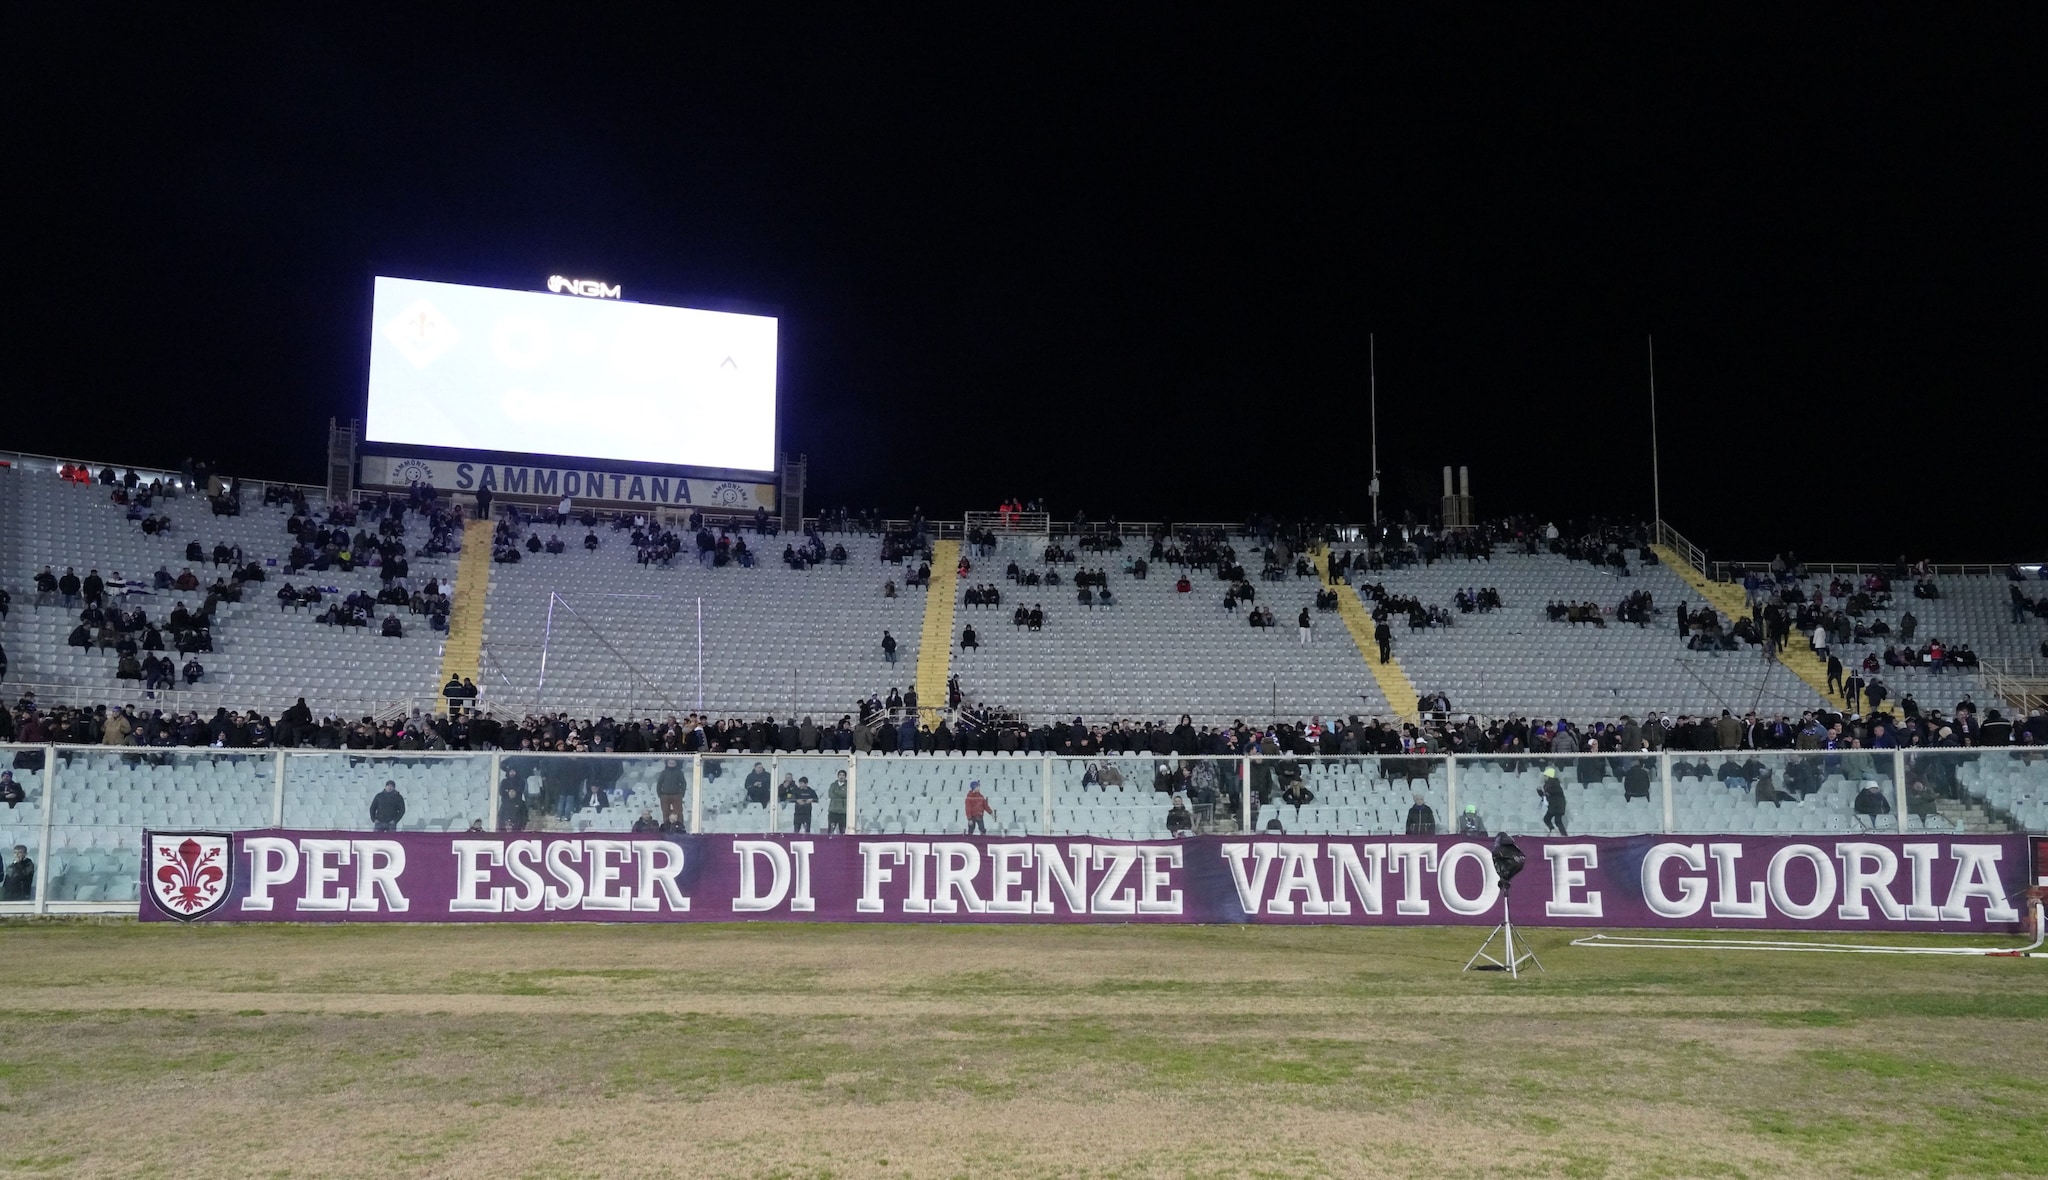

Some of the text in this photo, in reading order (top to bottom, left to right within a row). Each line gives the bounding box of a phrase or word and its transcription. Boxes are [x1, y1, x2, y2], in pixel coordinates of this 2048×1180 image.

[392, 459, 434, 480] SAMMONTANA
[456, 463, 692, 504] SAMMONTANA
[711, 482, 748, 502] SAMMONTANA
[241, 837, 2018, 922] PER ESSER DI FIRENZE VANTO E GLORIA
